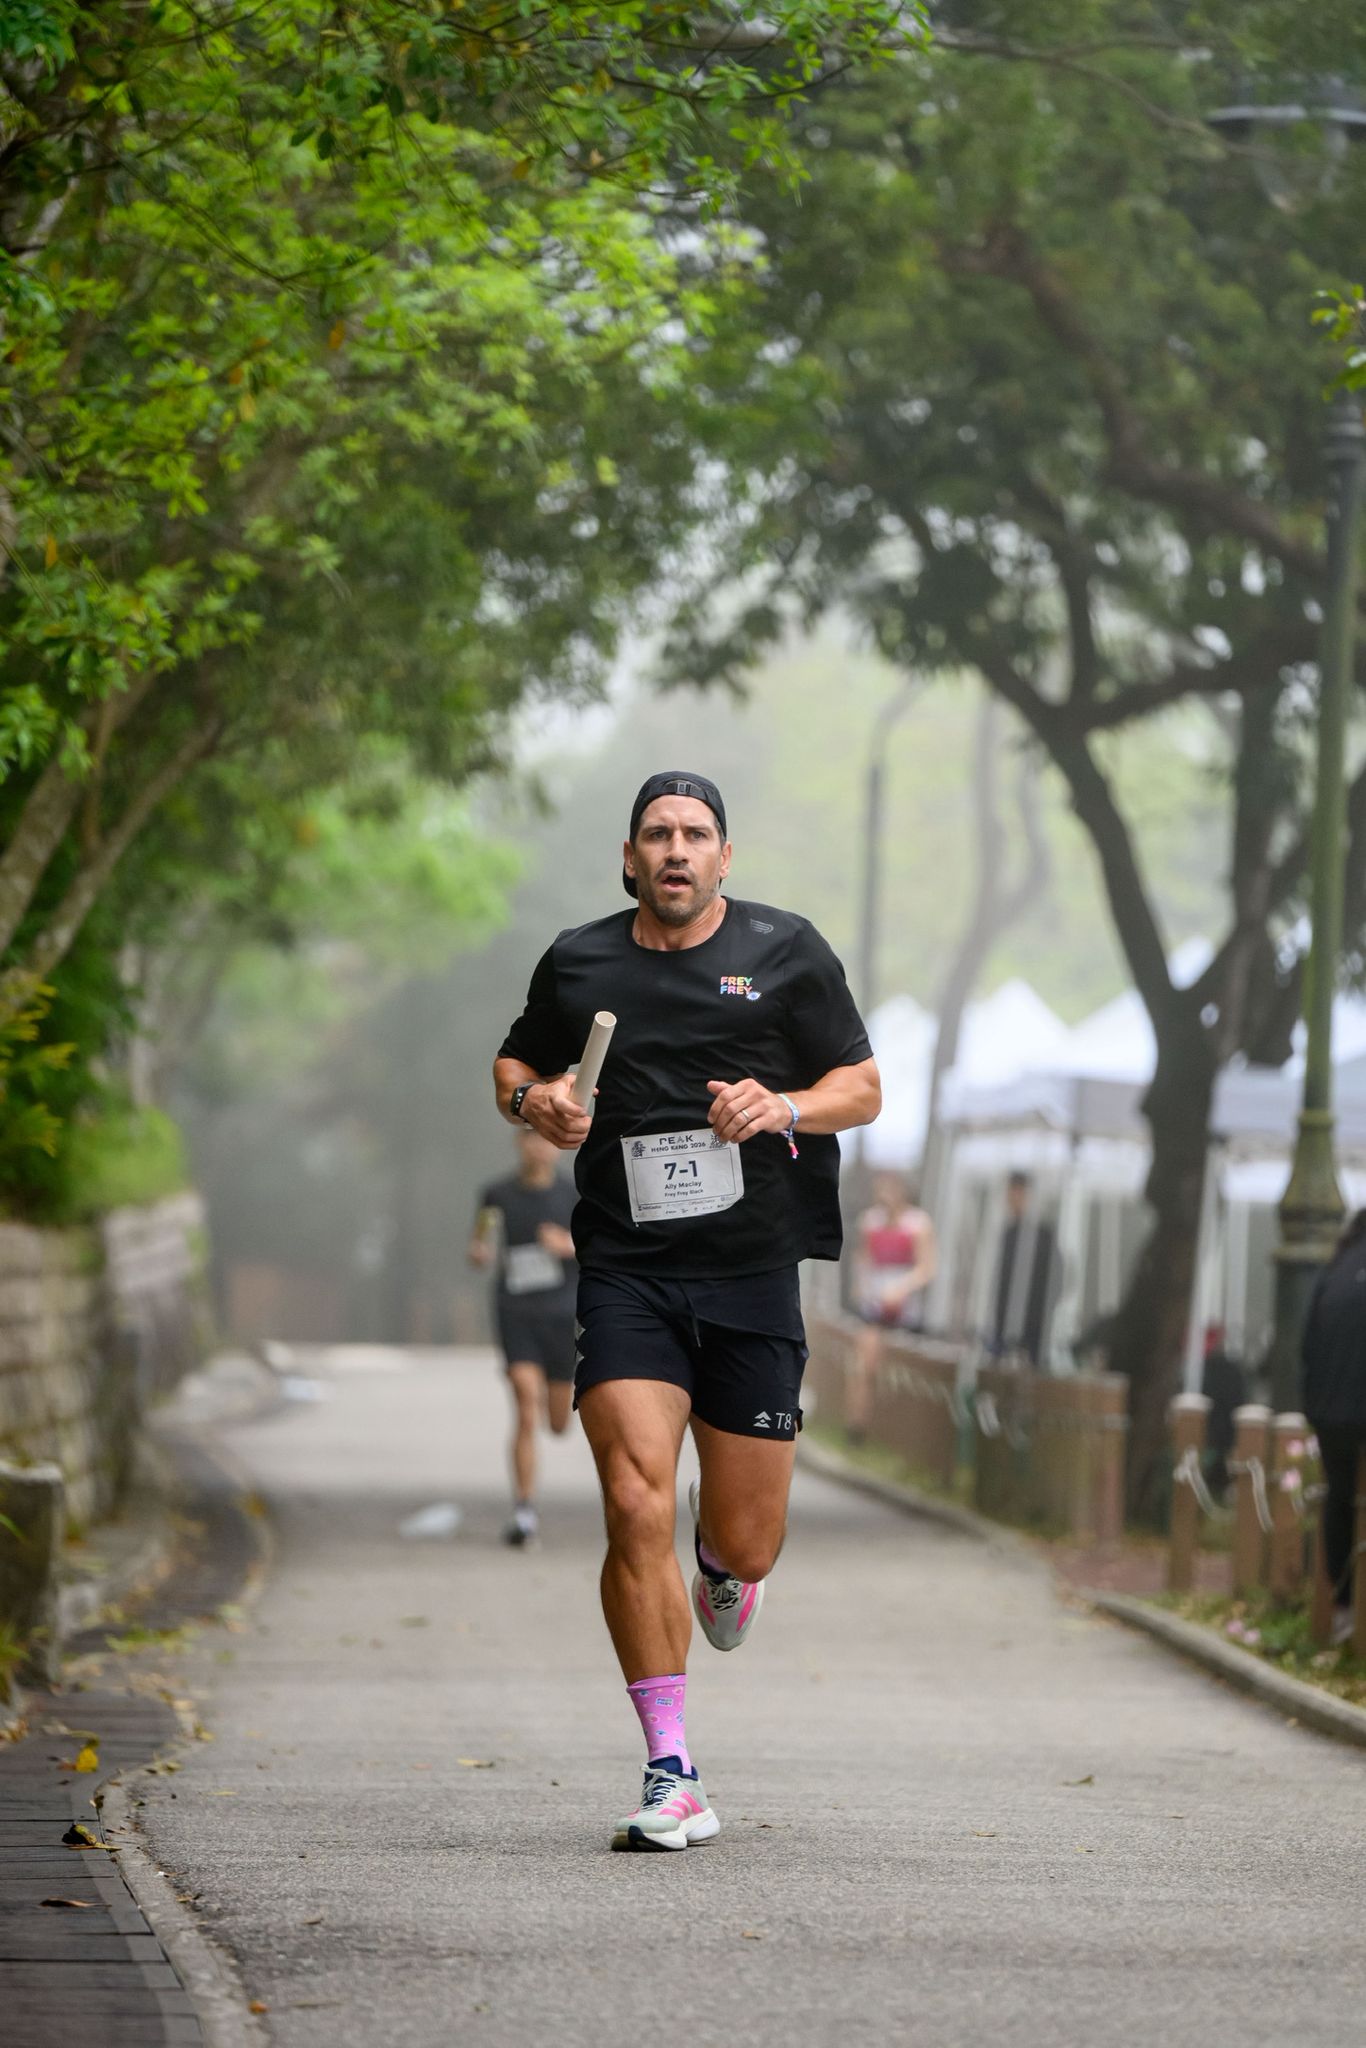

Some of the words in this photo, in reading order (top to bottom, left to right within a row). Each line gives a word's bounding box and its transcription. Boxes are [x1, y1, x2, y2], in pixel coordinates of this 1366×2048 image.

[720, 976, 753, 986] FREY
[720, 985, 753, 995] FREY
[659, 1134, 694, 1145] PEAK
[664, 1160, 698, 1180] 7-1
[664, 1183, 677, 1191] Ally
[775, 1412, 792, 1431] T8
